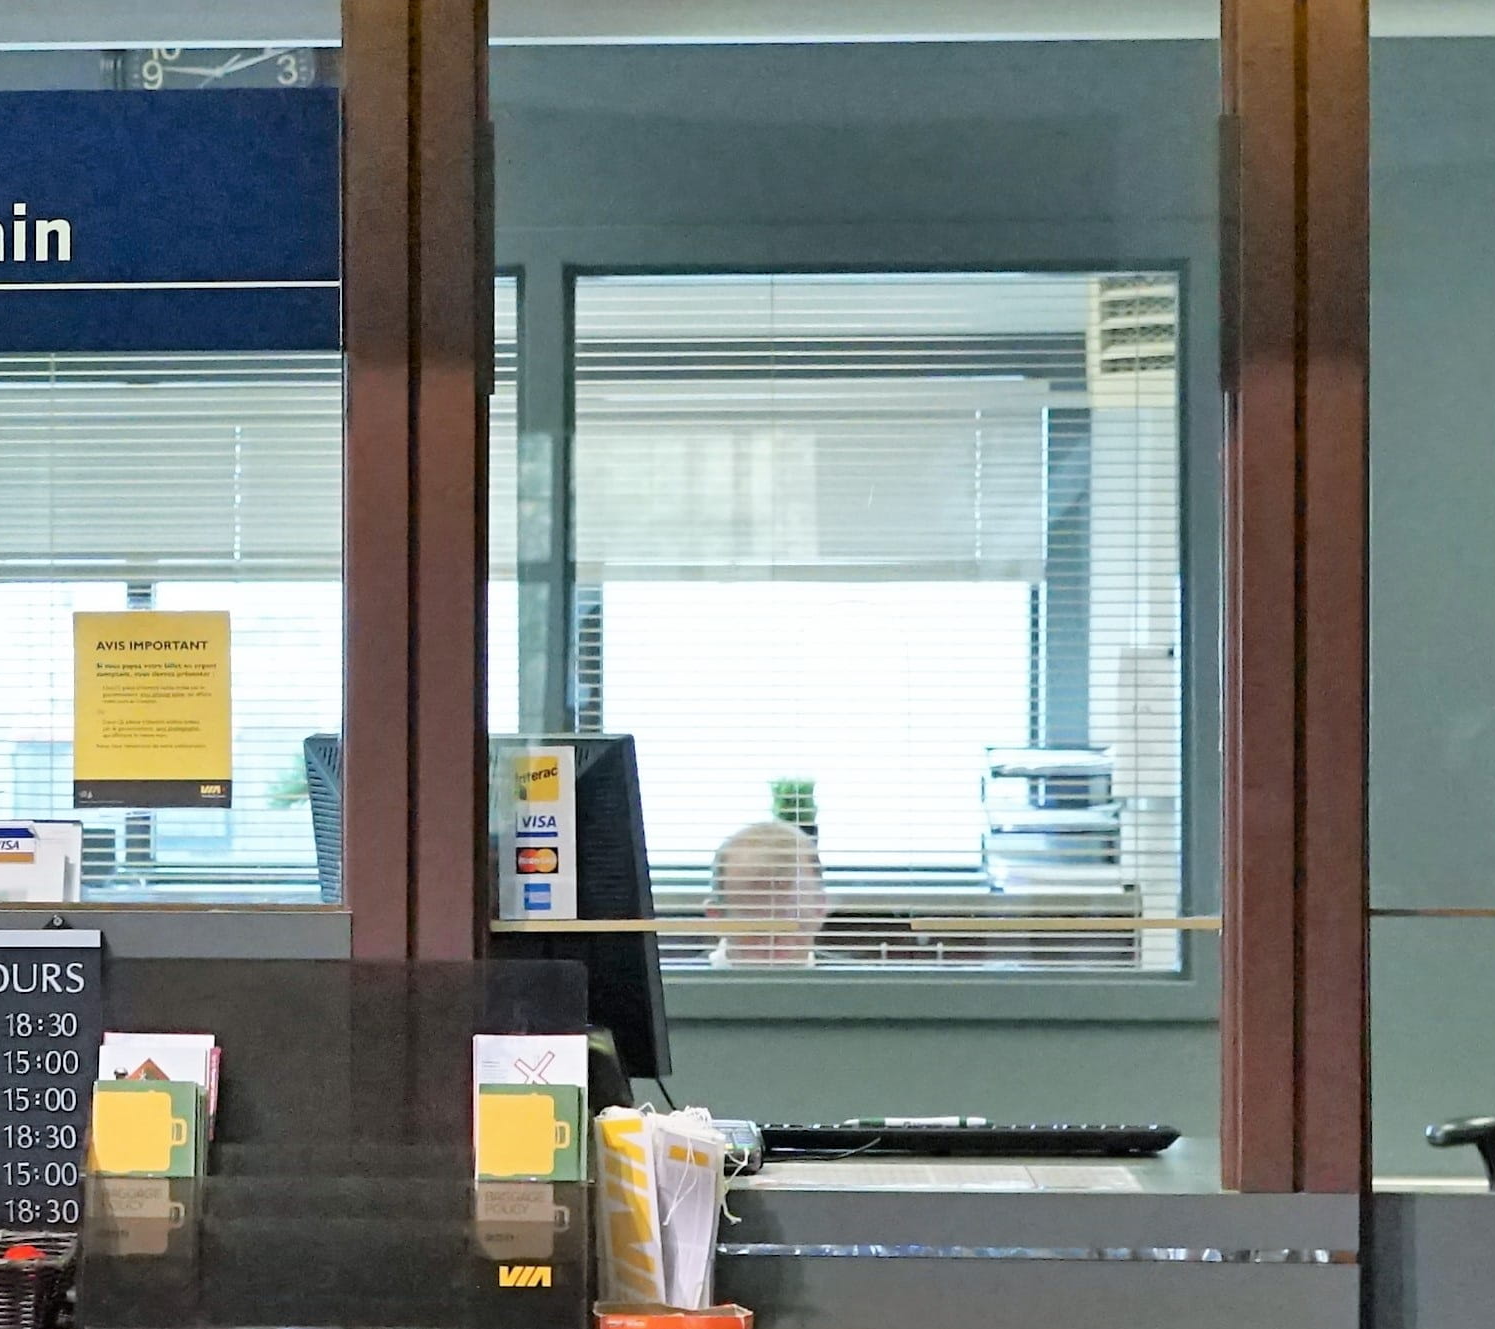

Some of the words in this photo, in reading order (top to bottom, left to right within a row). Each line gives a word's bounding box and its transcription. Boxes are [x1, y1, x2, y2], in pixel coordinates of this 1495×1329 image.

[276, 55, 299, 86] 3
[95, 640, 126, 651] AVIS
[129, 639, 209, 651] IMPORTANT
[522, 815, 557, 828] VISA
[5, 1012, 78, 1038] 18:30
[3, 1049, 80, 1075] 15:00
[3, 1087, 78, 1113] 15:00
[4, 1124, 77, 1150] 18:30
[3, 1161, 78, 1187] 15:00
[4, 1198, 79, 1224] 18:30
[498, 1265, 552, 1287] VIA
